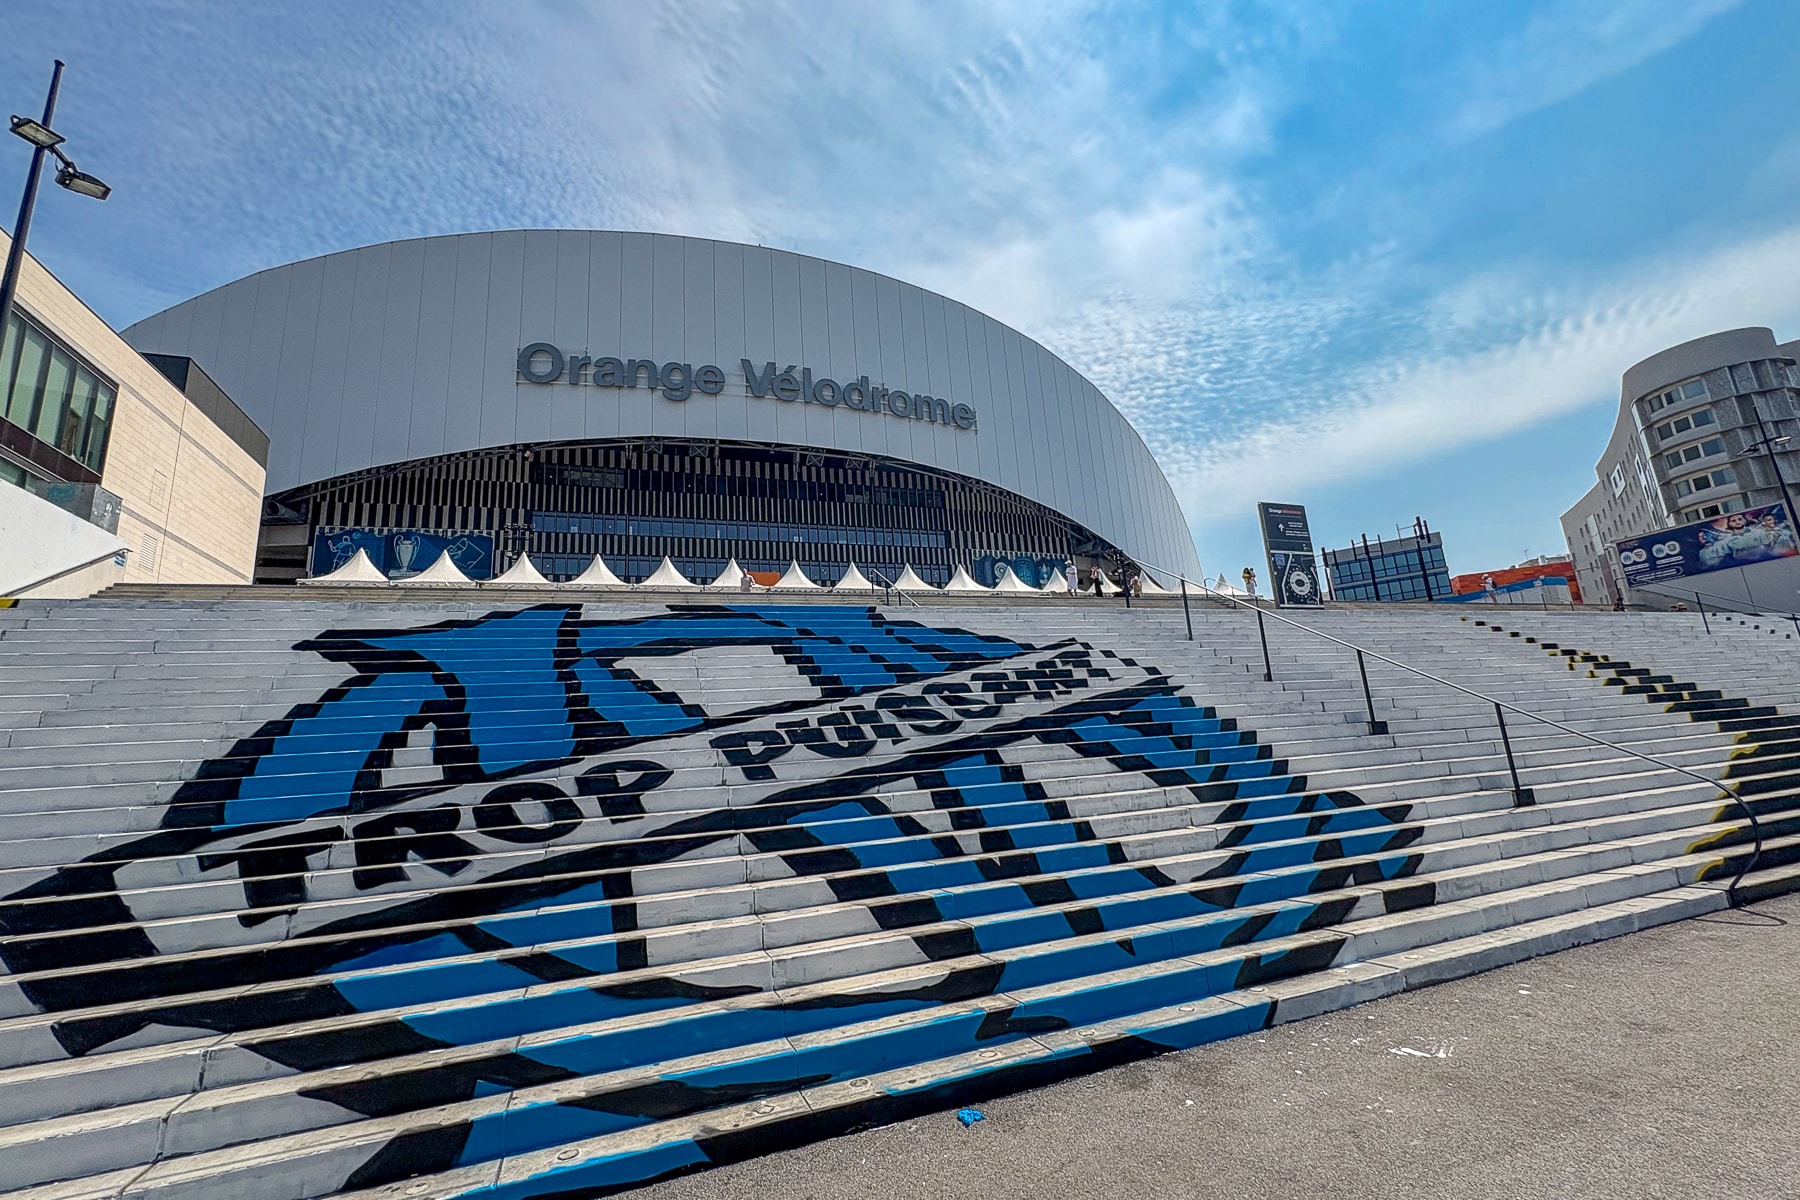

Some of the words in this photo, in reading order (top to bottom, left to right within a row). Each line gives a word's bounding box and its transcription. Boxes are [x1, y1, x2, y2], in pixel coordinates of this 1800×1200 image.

[518, 342, 725, 401] Orange
[741, 359, 976, 430] Vélodrome
[198, 760, 674, 927] TROP
[709, 651, 1116, 781] PUISSANT
